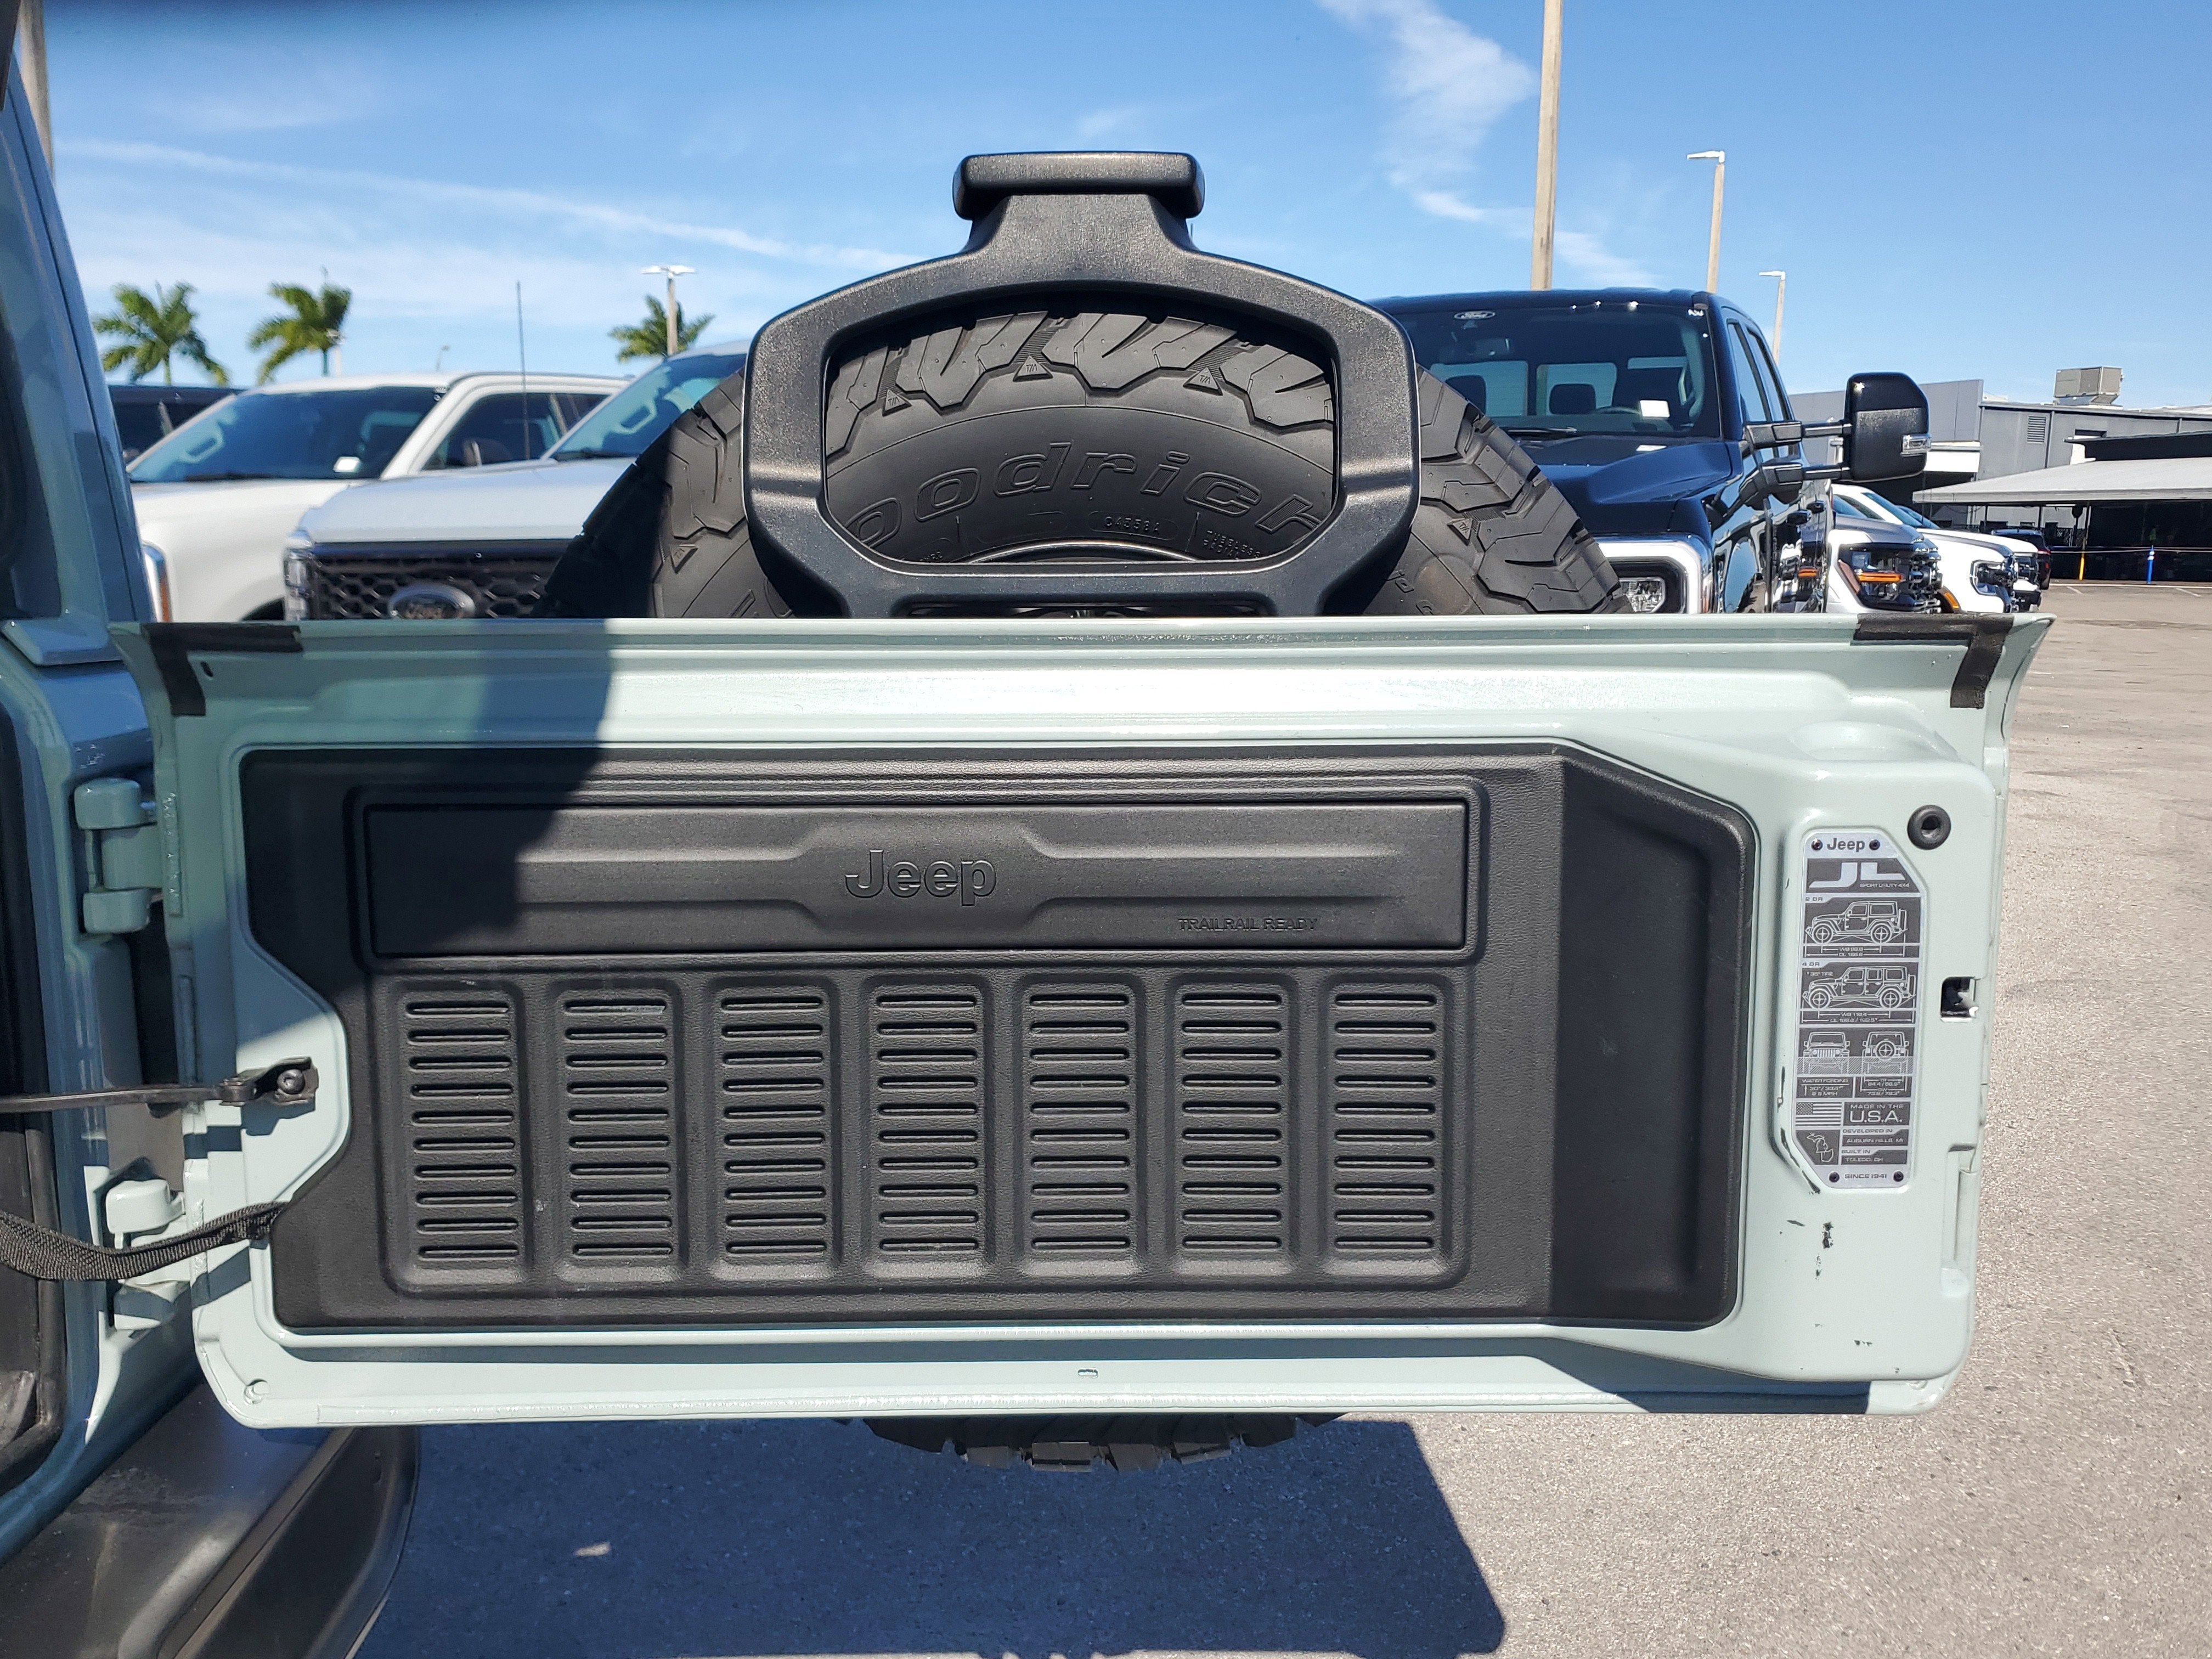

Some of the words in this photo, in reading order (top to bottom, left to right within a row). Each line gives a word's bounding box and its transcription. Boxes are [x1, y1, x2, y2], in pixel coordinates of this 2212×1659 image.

[1826, 837, 1865, 853] Jeep
[845, 850, 997, 907] Jeep
[1809, 862, 1906, 888] JL
[1178, 918, 1260, 932] TRAILRAIL
[1264, 918, 1318, 932] READY
[1849, 1110, 1903, 1123] U.S.A.
